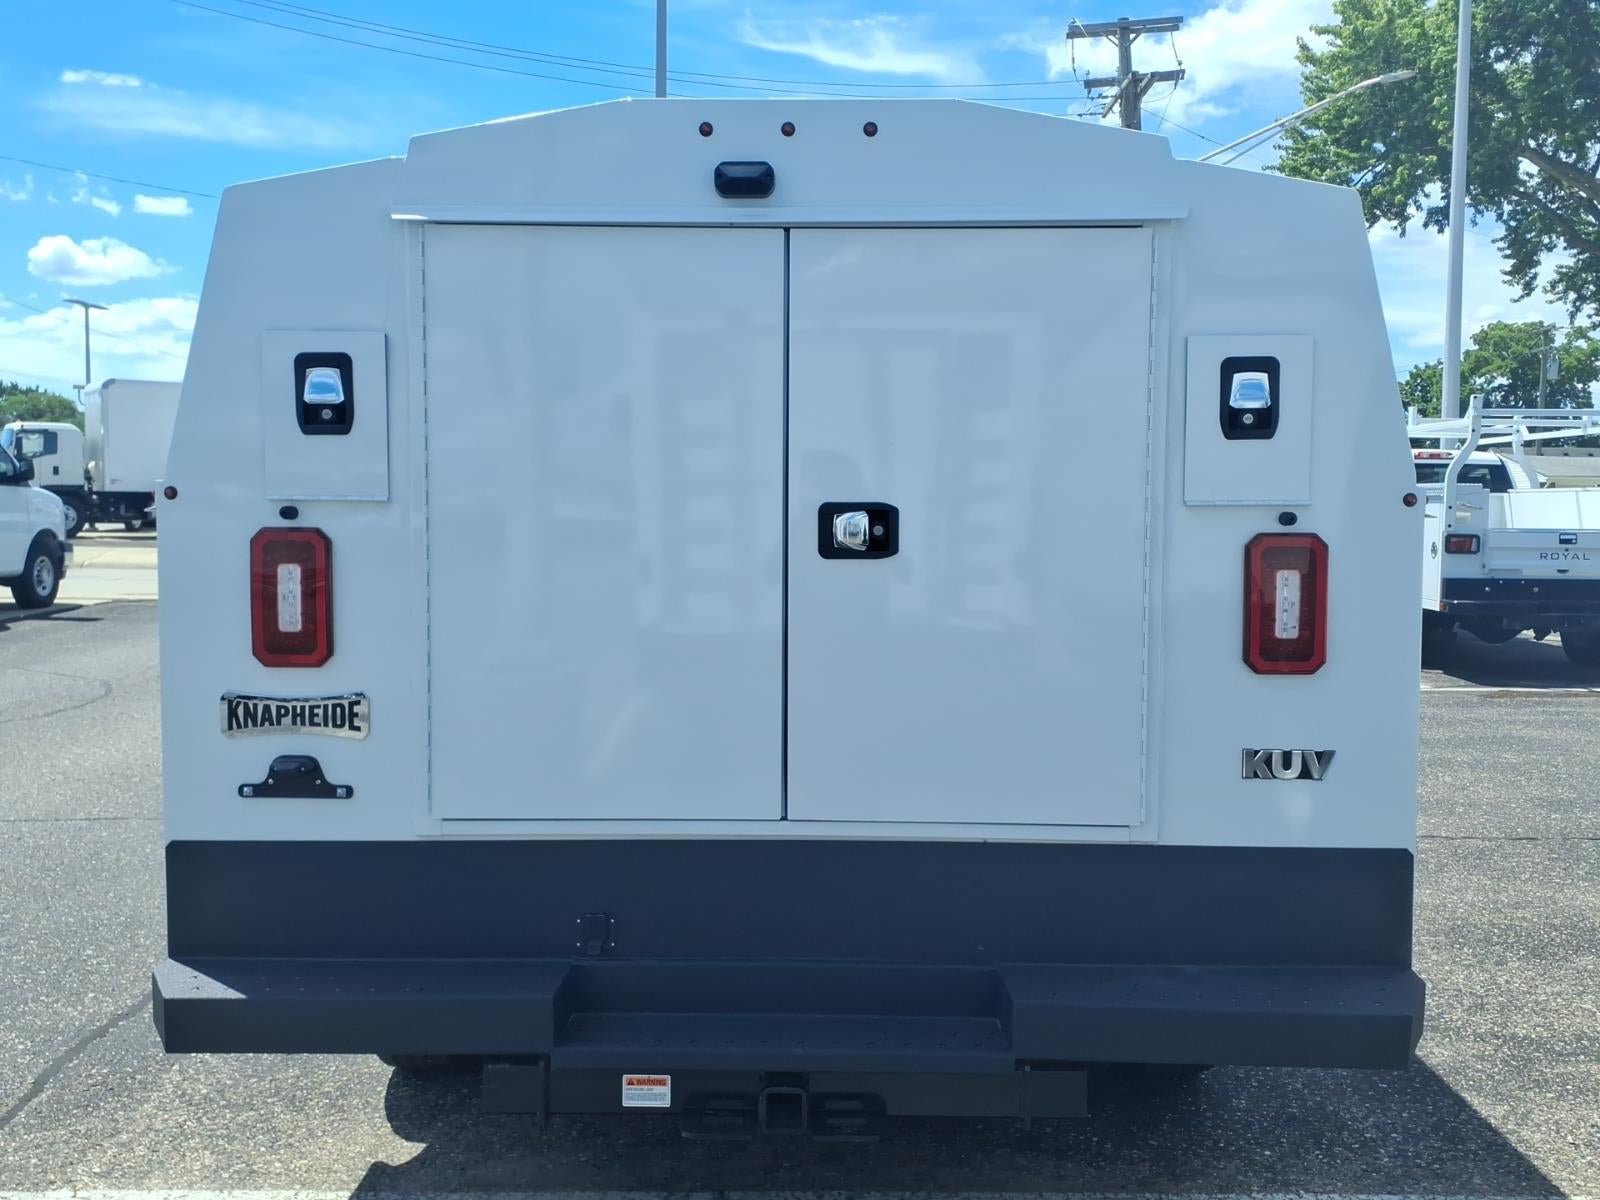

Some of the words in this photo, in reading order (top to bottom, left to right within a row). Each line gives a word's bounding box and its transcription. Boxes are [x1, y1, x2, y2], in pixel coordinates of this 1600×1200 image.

[1540, 552, 1591, 560] ROYAL
[227, 698, 361, 732] KNAPHEIDE
[1242, 748, 1336, 781] KUV
[636, 1078, 666, 1086] WARNING
